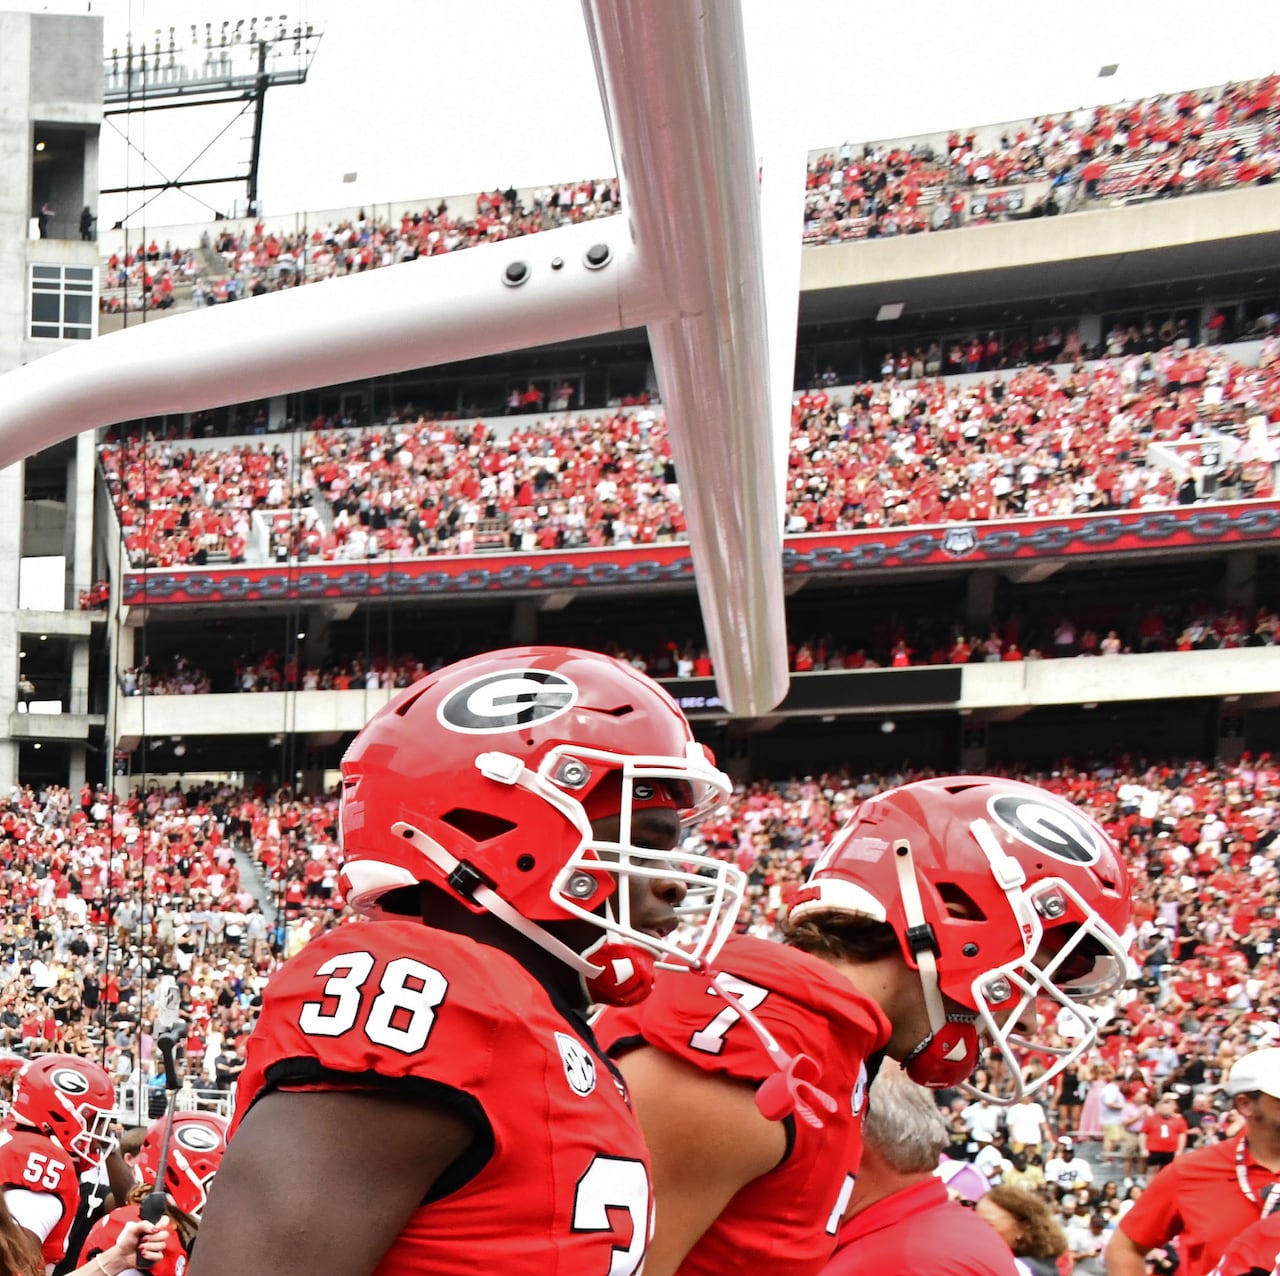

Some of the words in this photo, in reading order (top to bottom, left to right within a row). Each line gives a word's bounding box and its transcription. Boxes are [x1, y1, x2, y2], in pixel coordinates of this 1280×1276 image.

[299, 951, 448, 1055] 38
[689, 971, 771, 1055] 7
[22, 1150, 66, 1190] 55
